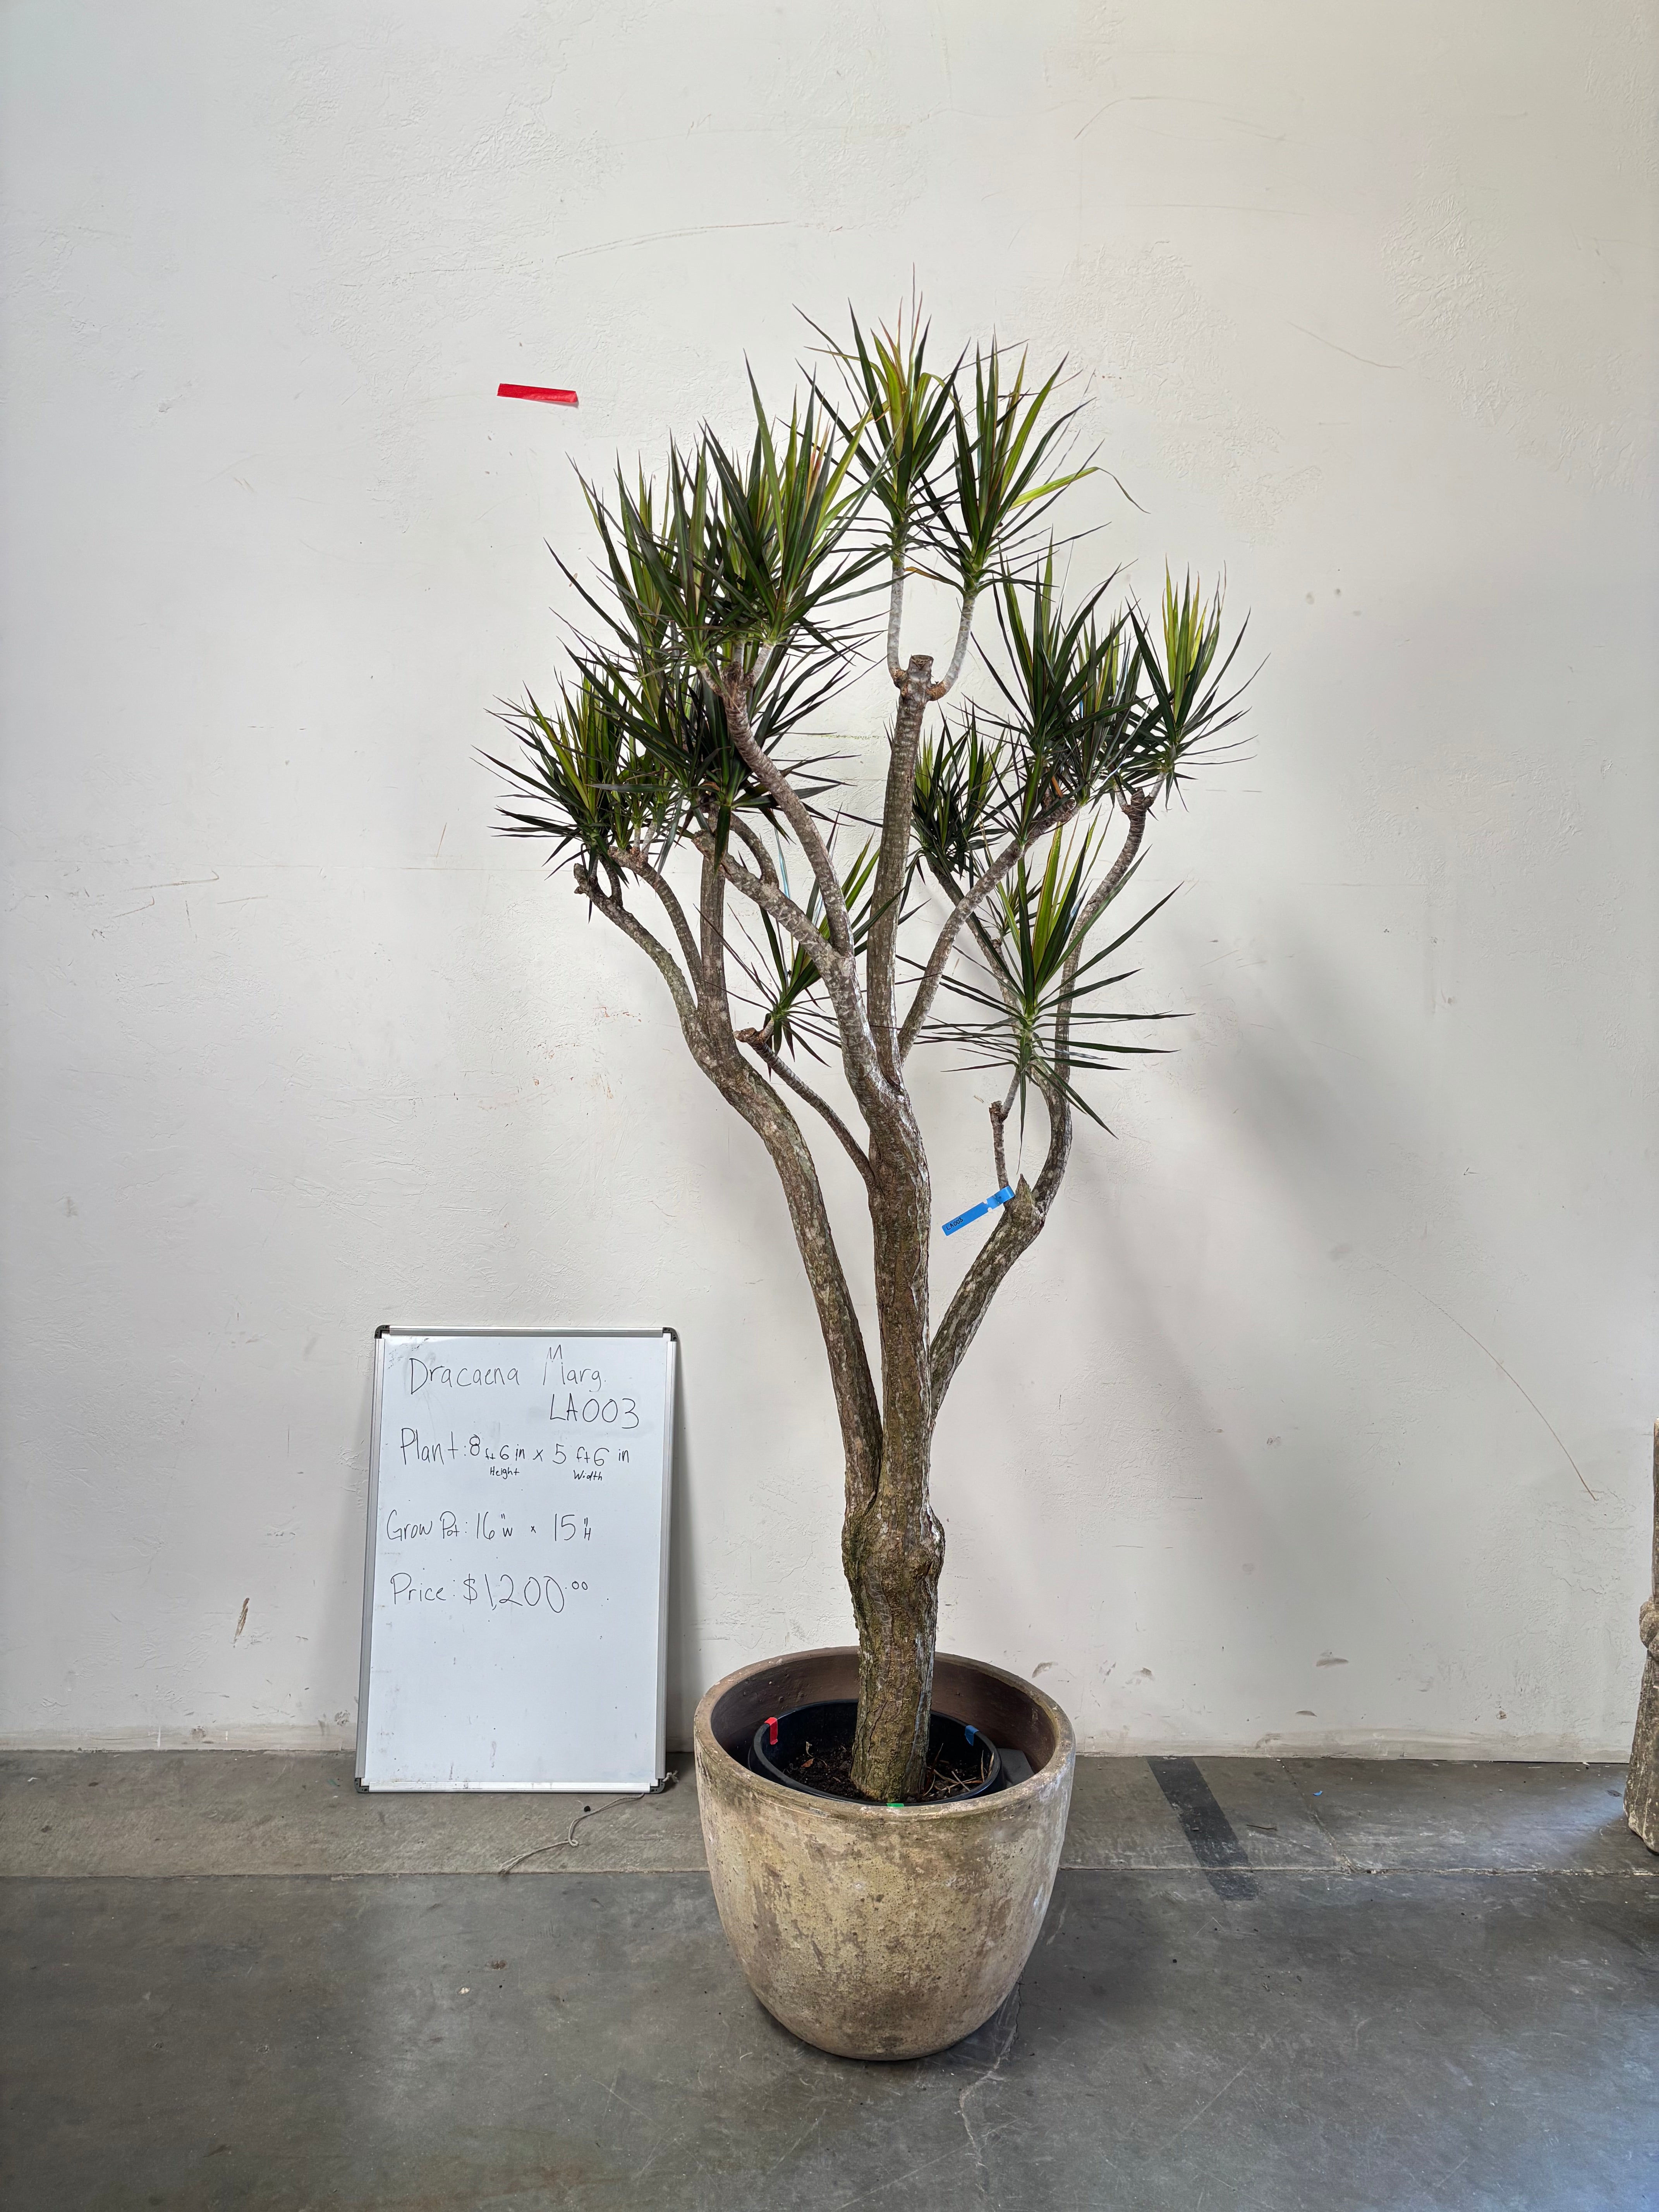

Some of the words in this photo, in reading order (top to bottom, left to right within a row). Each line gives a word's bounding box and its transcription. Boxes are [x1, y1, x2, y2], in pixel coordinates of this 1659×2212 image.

[946, 1217, 963, 1230] LA003
[409, 1358, 520, 1395] Dracaena
[550, 1393, 639, 1429] LA003
[400, 1427, 467, 1465] Plant:
[552, 1443, 567, 1465] 5
[490, 1466, 520, 1480] Height
[573, 1469, 603, 1481] Width
[387, 1509, 433, 1541] Grow
[390, 1572, 455, 1605] Price:
